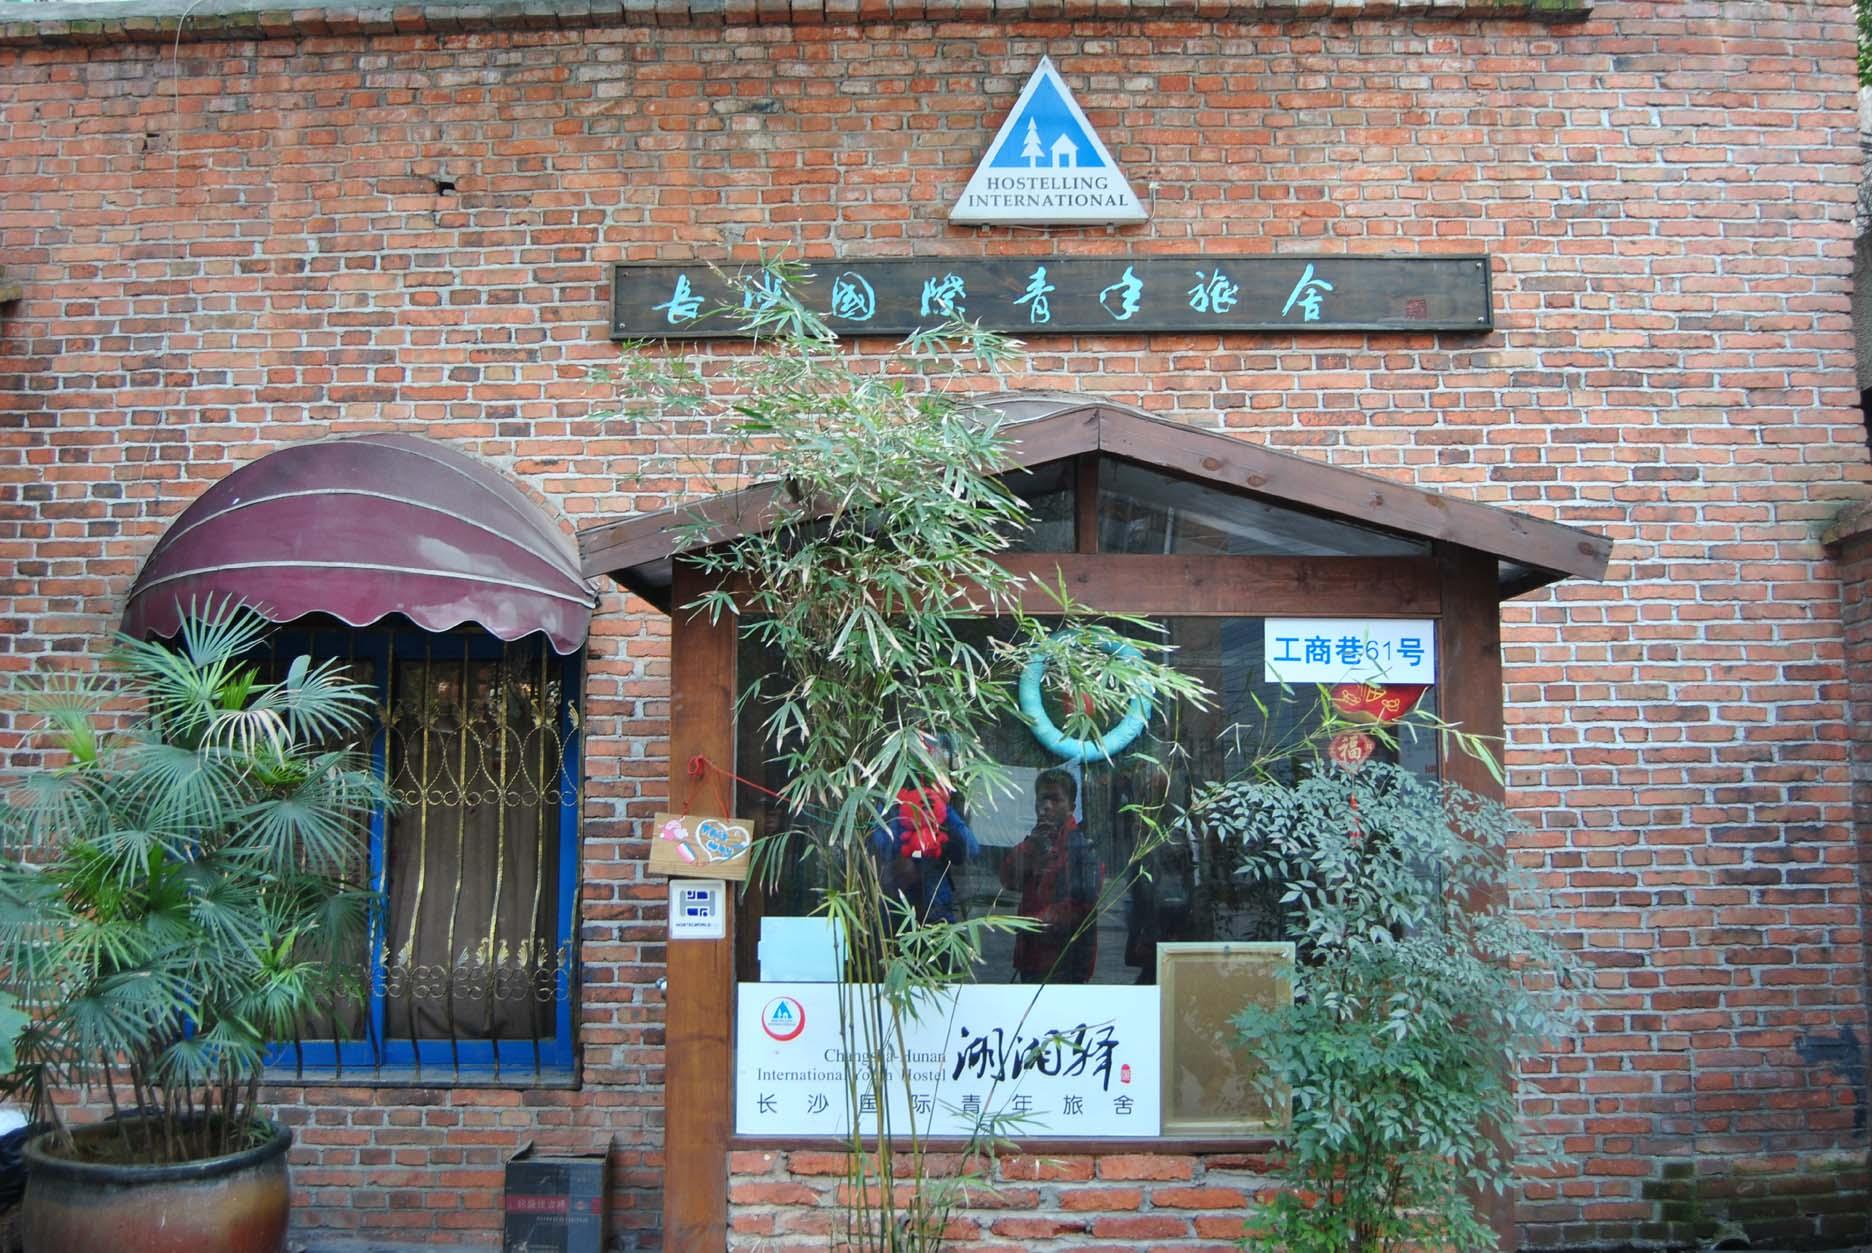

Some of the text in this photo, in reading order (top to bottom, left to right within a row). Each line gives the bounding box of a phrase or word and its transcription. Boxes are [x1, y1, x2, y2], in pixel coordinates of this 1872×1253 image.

[986, 176, 1109, 190] HOSTELLING
[968, 193, 1129, 207] INTERNATIONAL
[1272, 635, 1425, 667] 工商巷61号
[1338, 735, 1361, 761] 福
[756, 1092, 1135, 1116] 长沙国际青年旅舍
